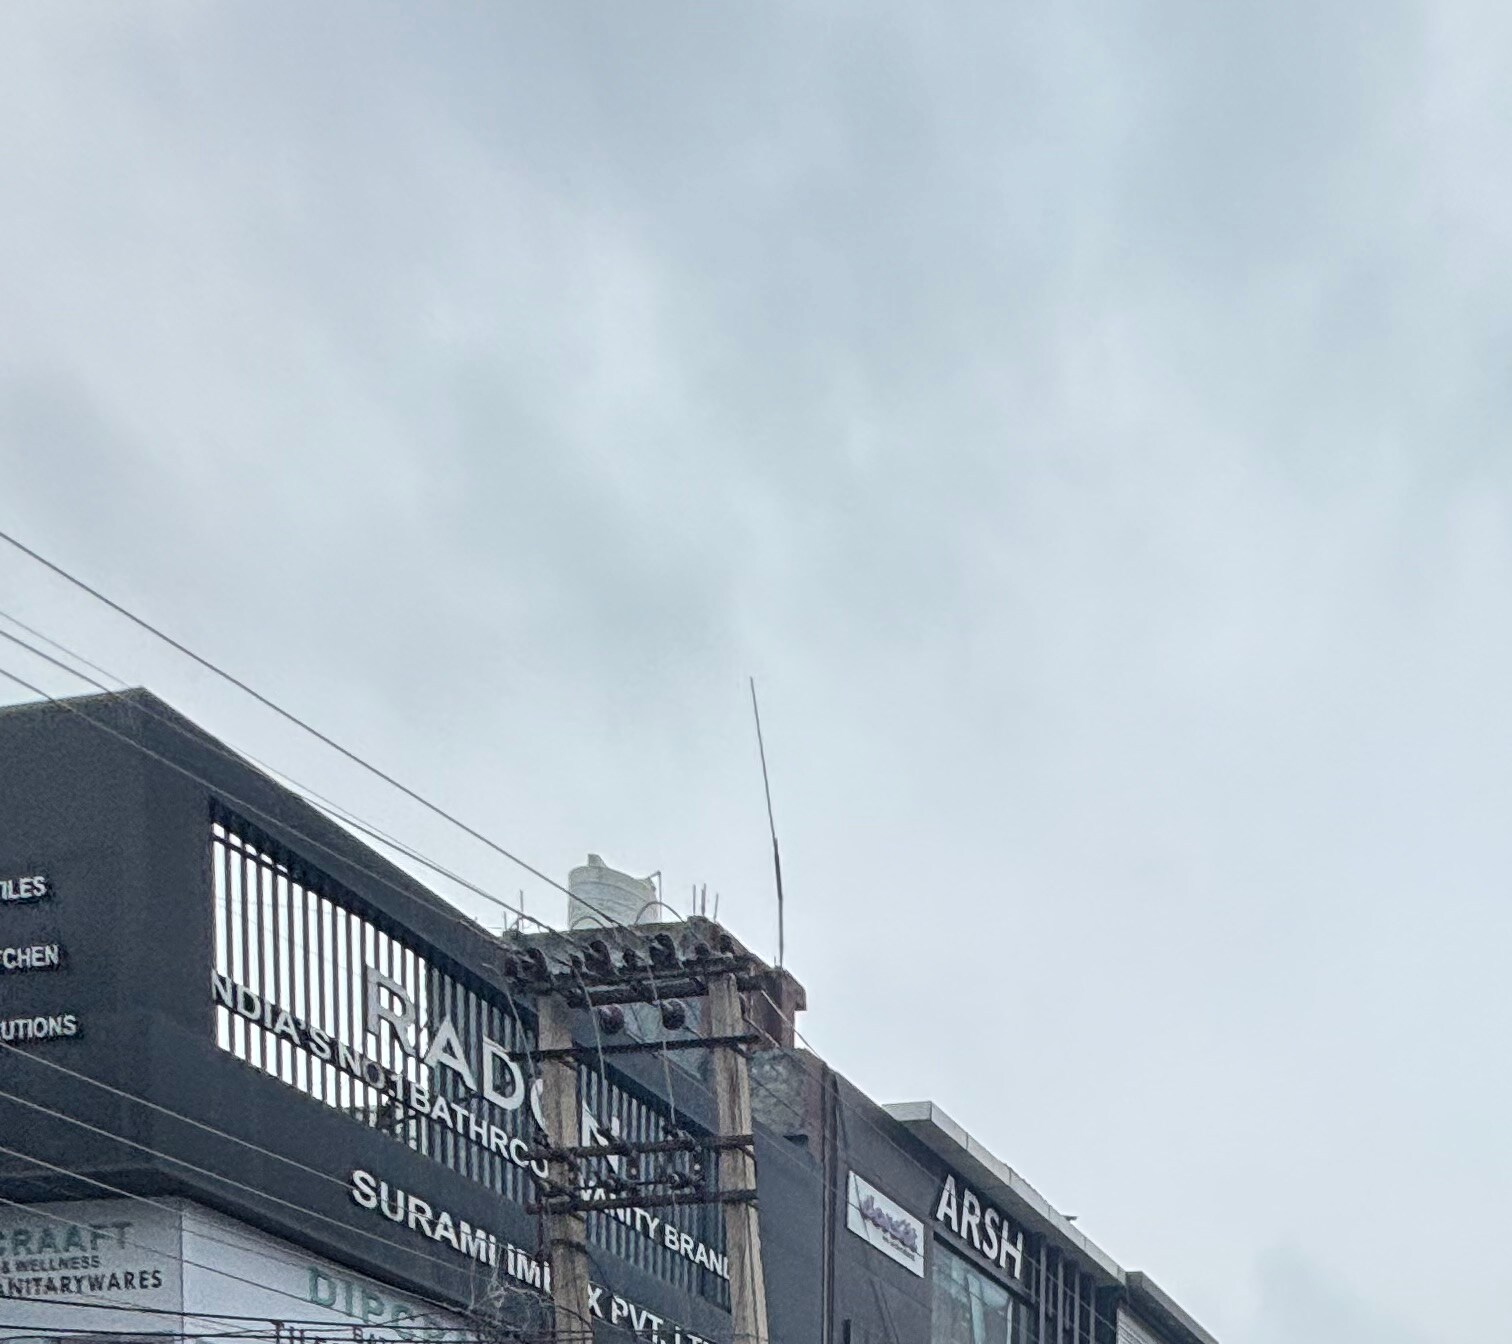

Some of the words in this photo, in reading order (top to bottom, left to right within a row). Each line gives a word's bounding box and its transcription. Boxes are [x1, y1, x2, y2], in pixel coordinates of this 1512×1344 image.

[0, 944, 59, 969] CHEN
[936, 1173, 1023, 1280] ARSH
[15, 1254, 101, 1272] WELLNESS
[507, 1243, 603, 1319] IMX
